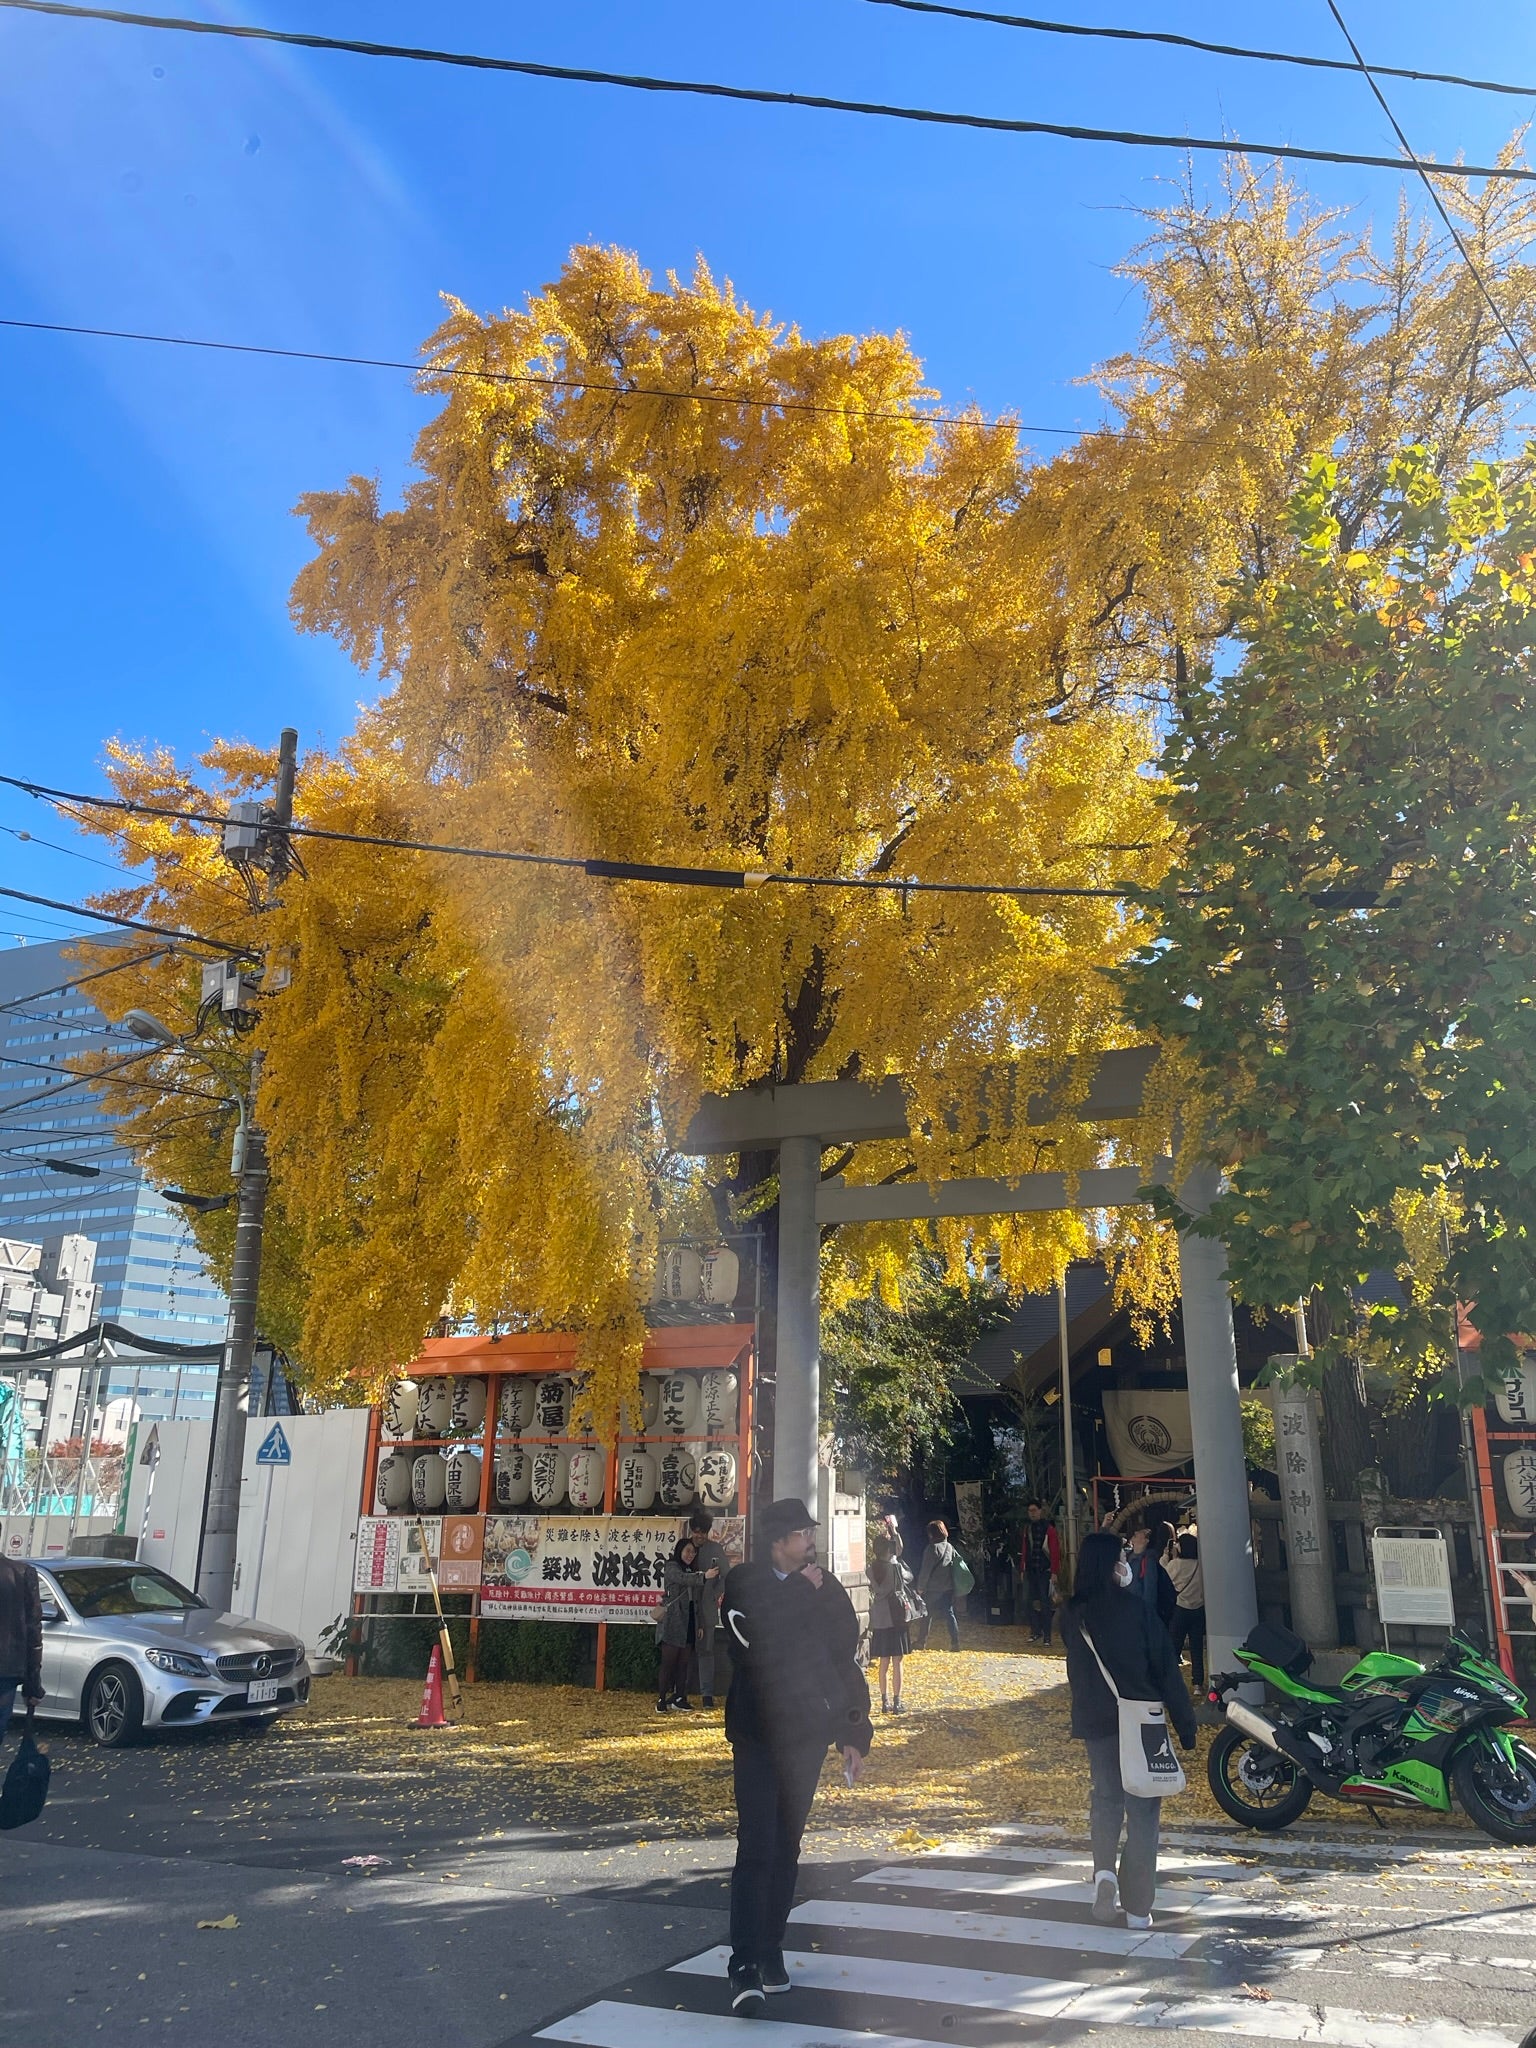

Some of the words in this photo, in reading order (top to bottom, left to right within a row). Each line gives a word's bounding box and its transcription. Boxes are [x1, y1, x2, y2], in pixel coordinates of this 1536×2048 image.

[420, 1384, 436, 1430] すし大
[452, 1388, 469, 1428] サイトウ
[540, 1382, 564, 1427] 菊屋
[663, 1380, 685, 1426] 紀文
[448, 1458, 463, 1507] 小田原屋
[624, 1459, 635, 1508] ジョウコウ
[699, 1456, 723, 1503] 玉八
[1283, 1412, 1320, 1555] 波除神社
[545, 1528, 601, 1544] 災難を除き
[608, 1529, 677, 1544] 波を乗り切る
[542, 1556, 582, 1582] 築地
[421, 1656, 437, 1716] 駐車禁止
[1453, 1687, 1480, 1701] Ninja
[1392, 1769, 1440, 1799] Kawasaki
